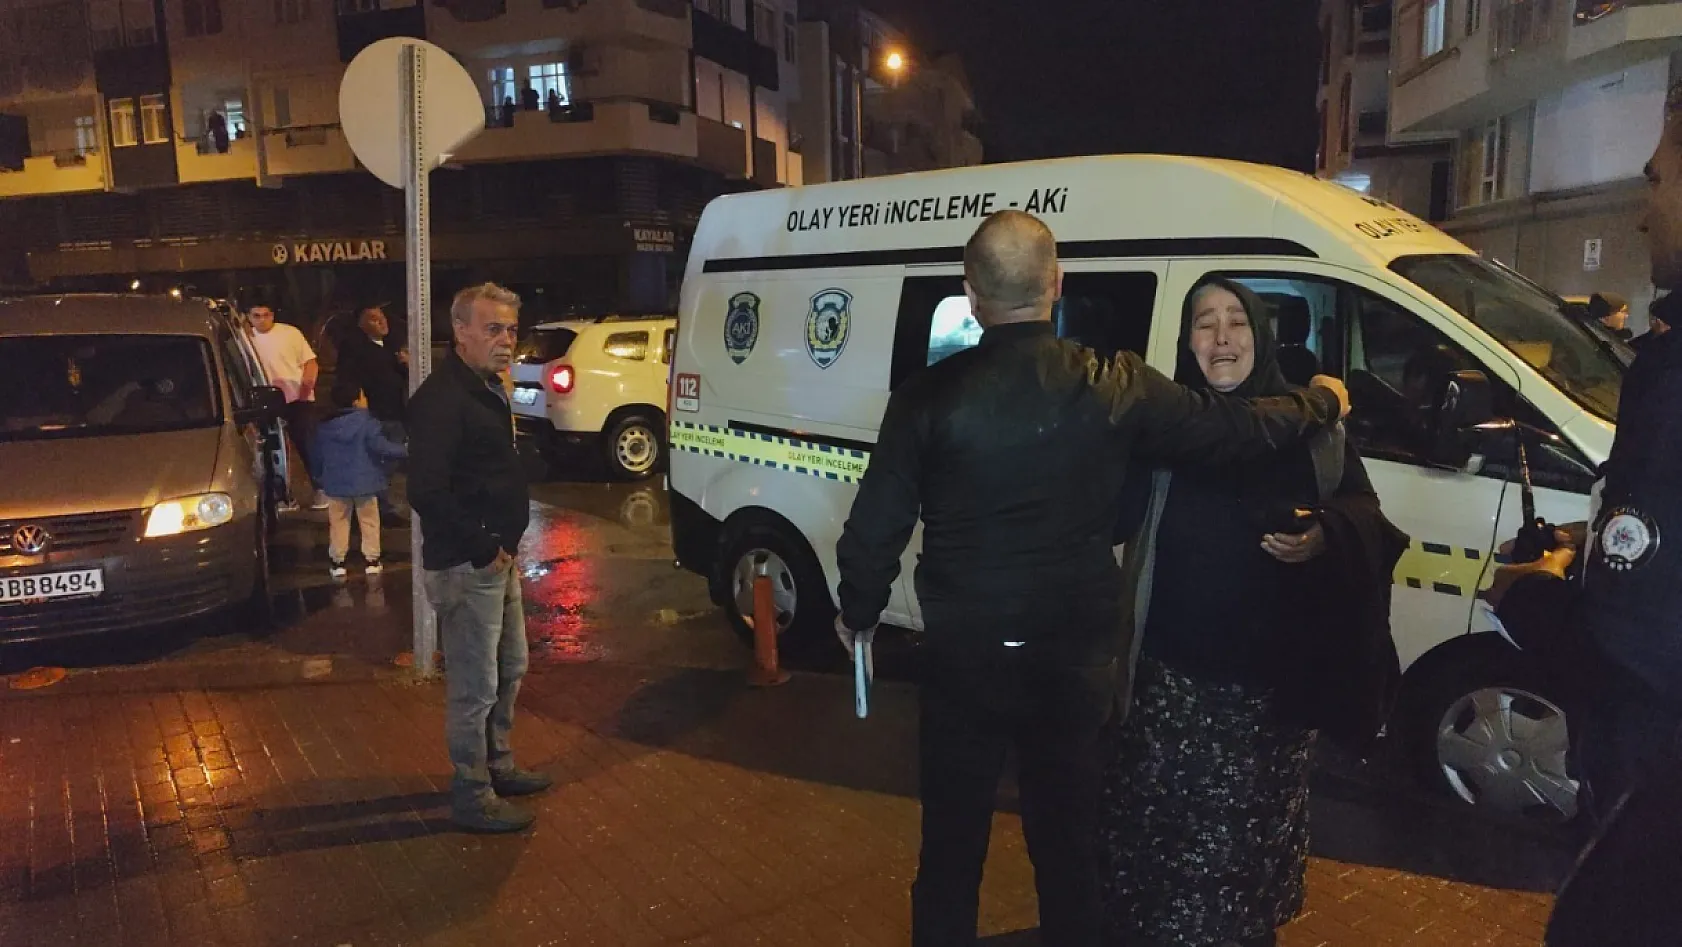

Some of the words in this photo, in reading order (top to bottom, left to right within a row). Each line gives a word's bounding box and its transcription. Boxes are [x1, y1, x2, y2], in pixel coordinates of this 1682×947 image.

[786, 207, 834, 232] OLAY
[633, 229, 675, 243] KAYALAR
[294, 240, 387, 262] KAYALAR
[680, 377, 697, 397] 112
[788, 450, 806, 462] OLAY
